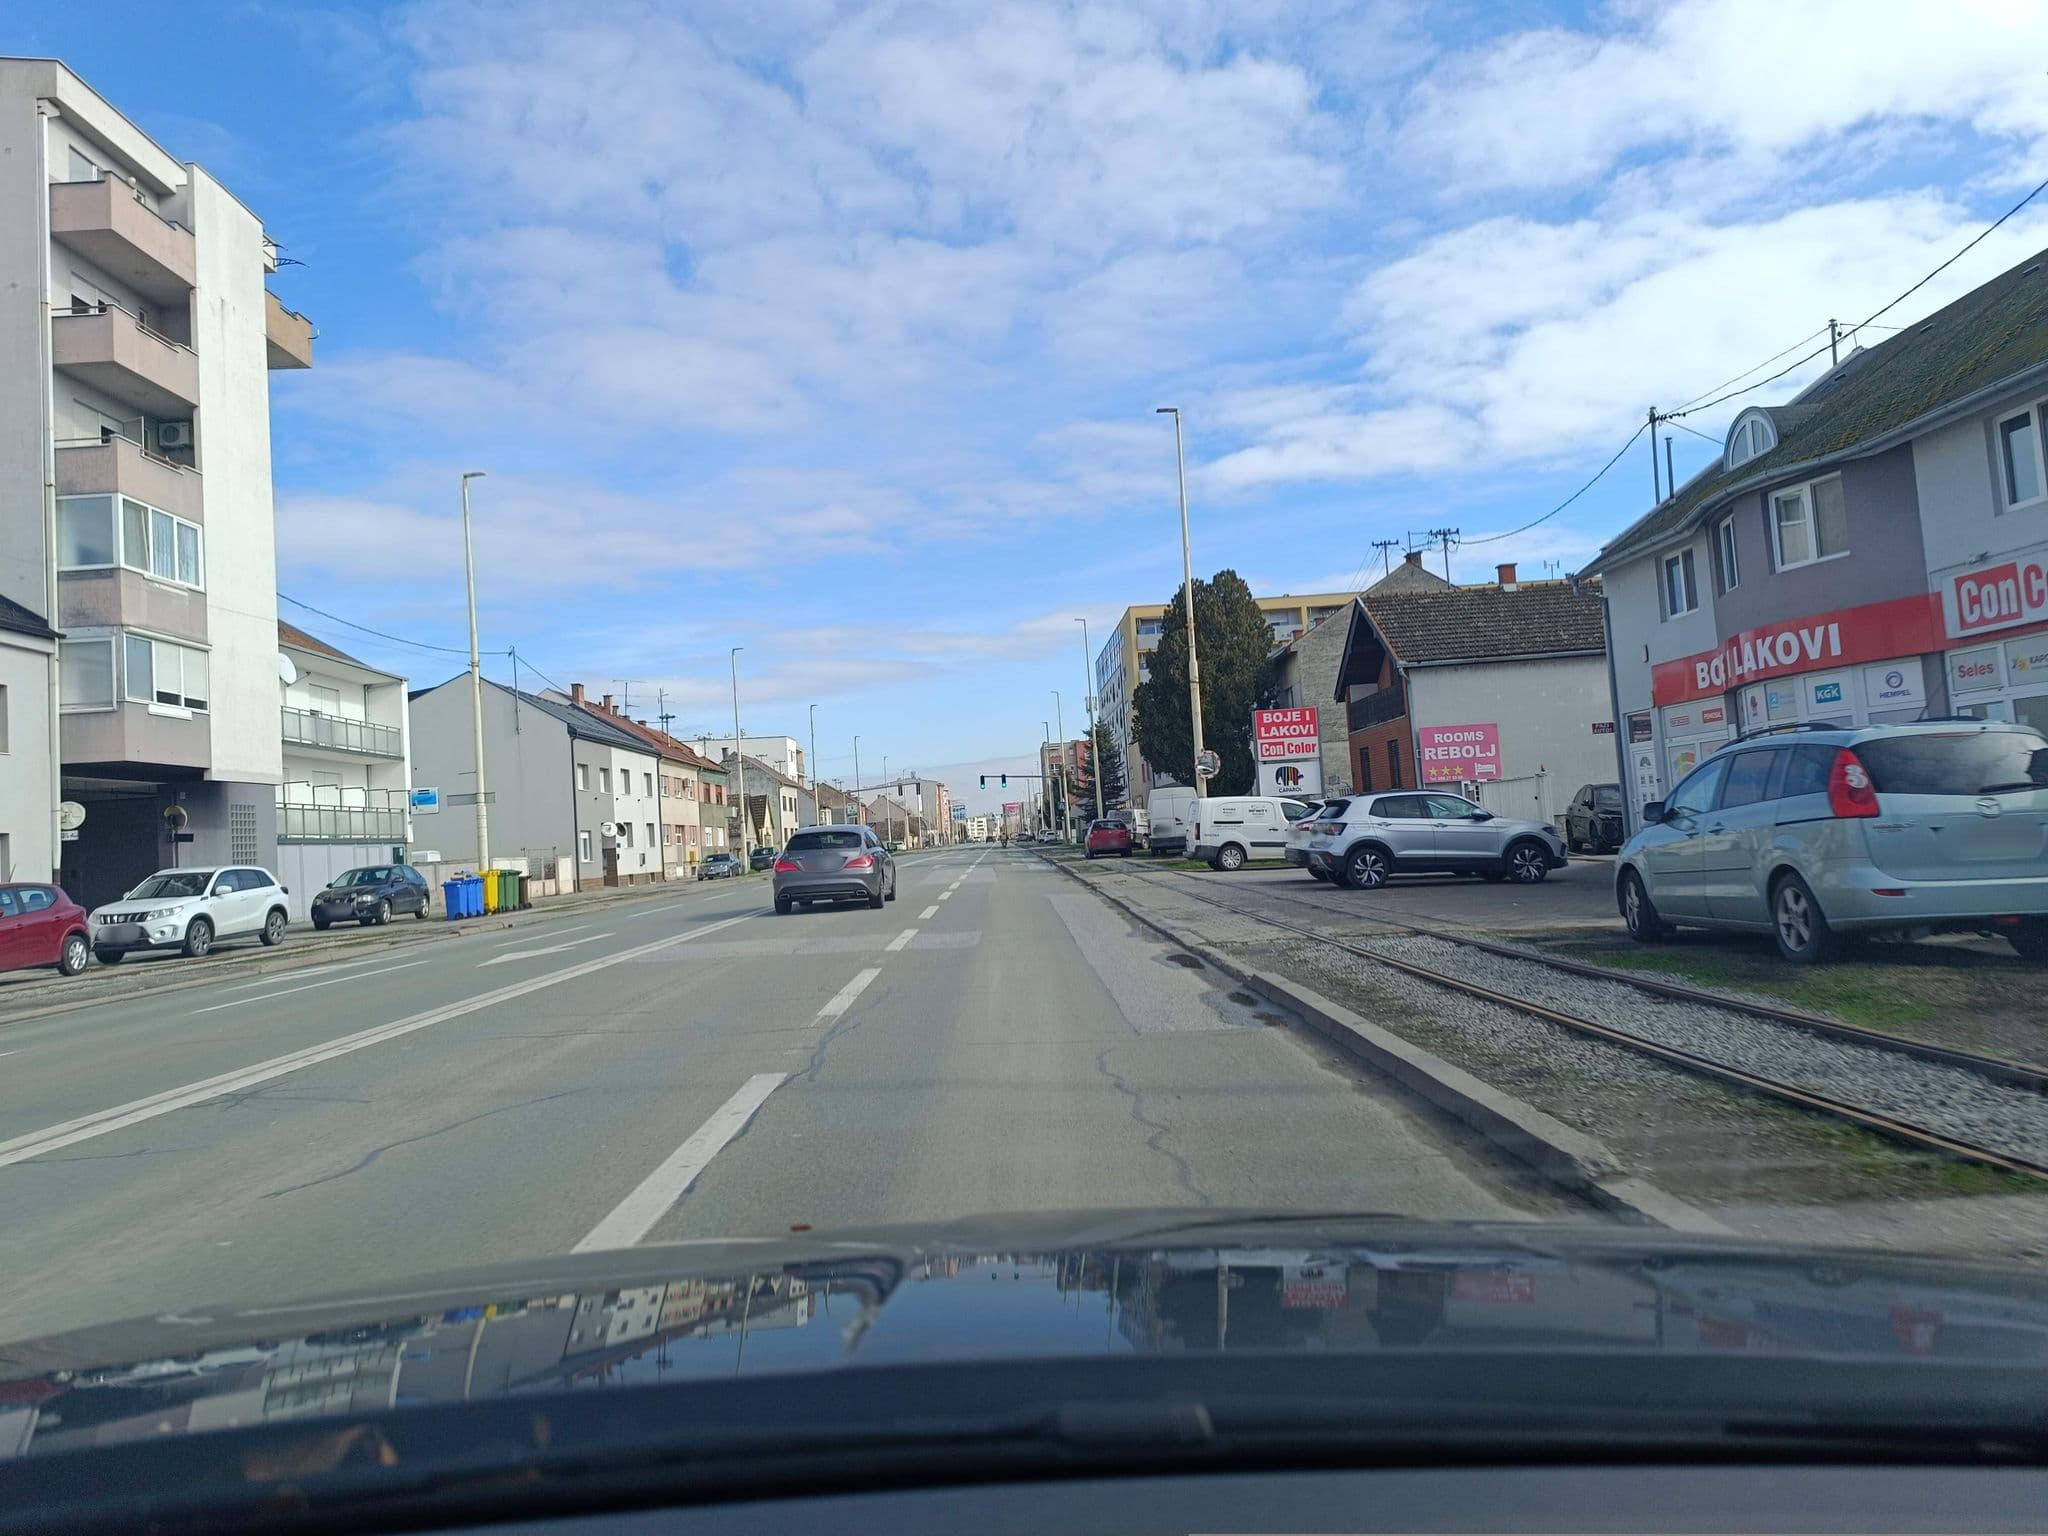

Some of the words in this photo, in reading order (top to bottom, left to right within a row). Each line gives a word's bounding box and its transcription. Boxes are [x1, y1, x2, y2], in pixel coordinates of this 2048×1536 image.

[1960, 578, 2018, 623] Con
[2023, 563, 2048, 609] C
[1733, 622, 1841, 675] LAKOVI
[1958, 663, 1994, 679] Seles
[1816, 687, 1839, 700] KGK
[1880, 689, 1912, 698] HEMPEL
[1263, 711, 1301, 723] BOJE
[1305, 710, 1310, 721] I
[1261, 724, 1315, 737] LAKOVI
[1434, 731, 1484, 743] ROOMS
[1262, 743, 1284, 756] Con
[1287, 742, 1316, 754] Color
[1424, 744, 1496, 760] REBOLJ
